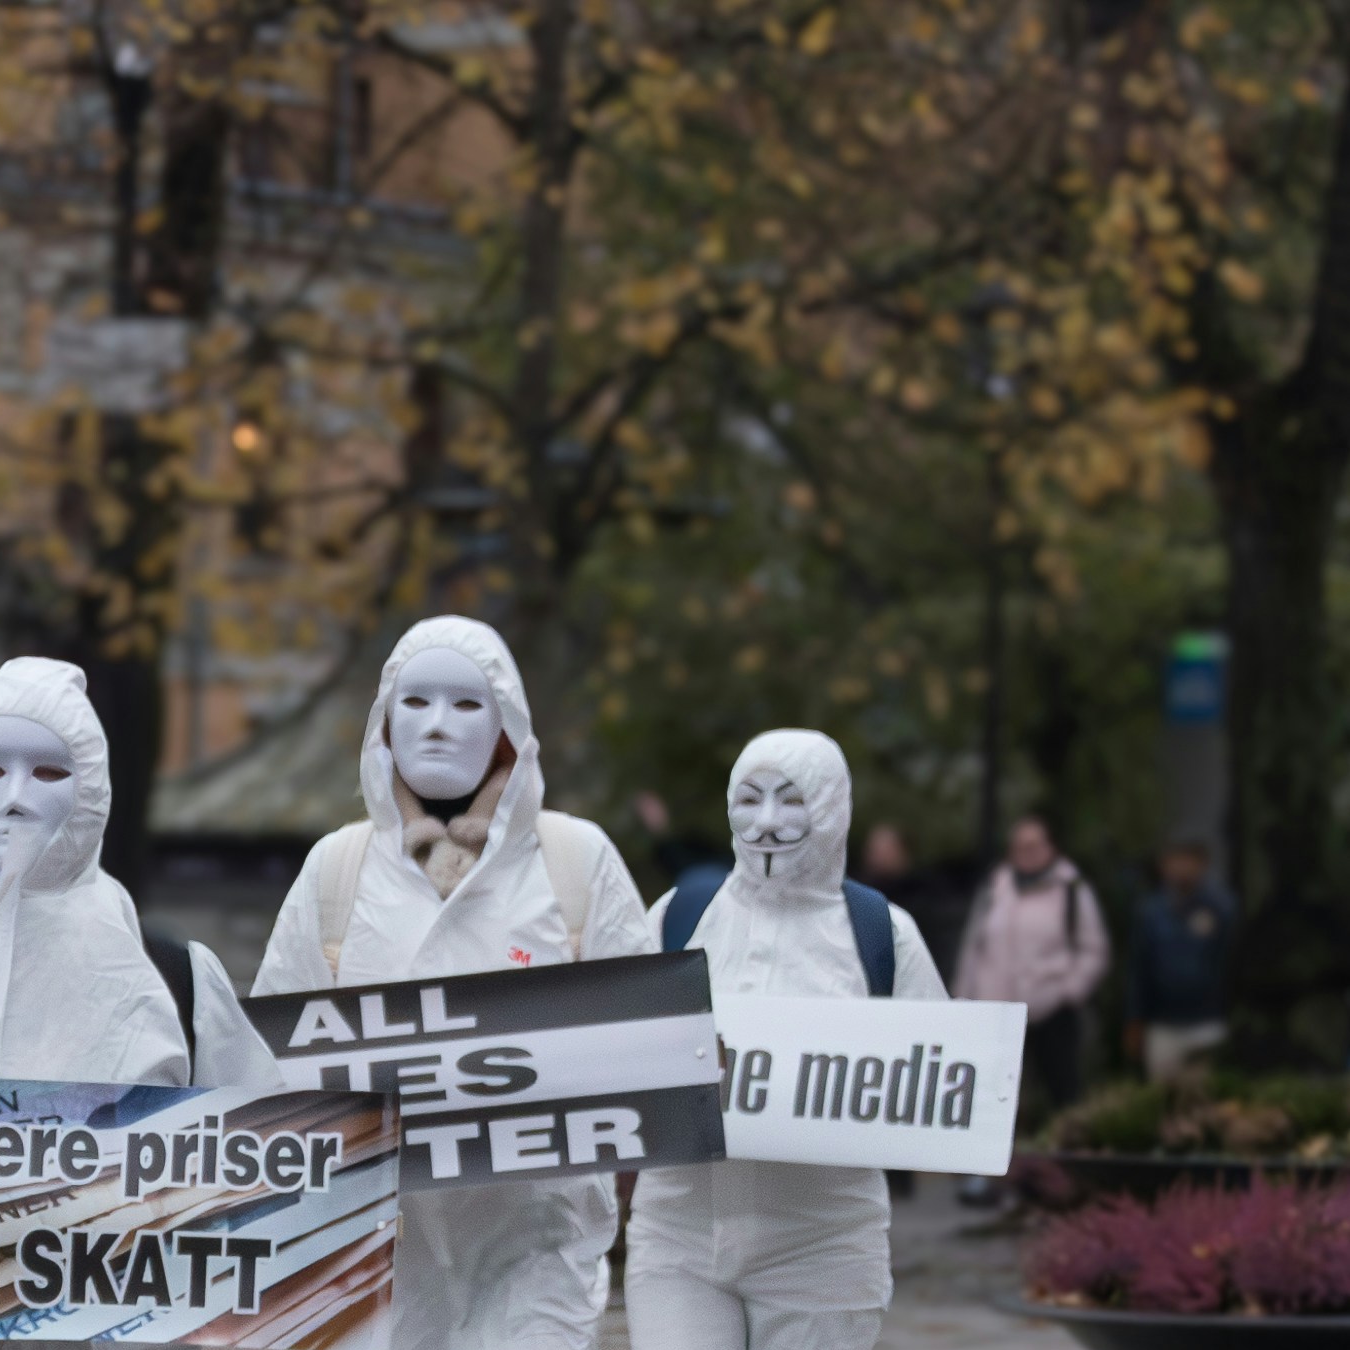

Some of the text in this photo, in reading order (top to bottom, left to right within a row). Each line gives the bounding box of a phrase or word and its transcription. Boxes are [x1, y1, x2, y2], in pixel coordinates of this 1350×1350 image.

[507, 945, 531, 968] 3M
[287, 986, 477, 1047] ALL
[793, 1043, 977, 1130] media
[125, 1116, 339, 1196] priser
[405, 1108, 646, 1180] TER
[19, 1228, 272, 1311] SKATT
